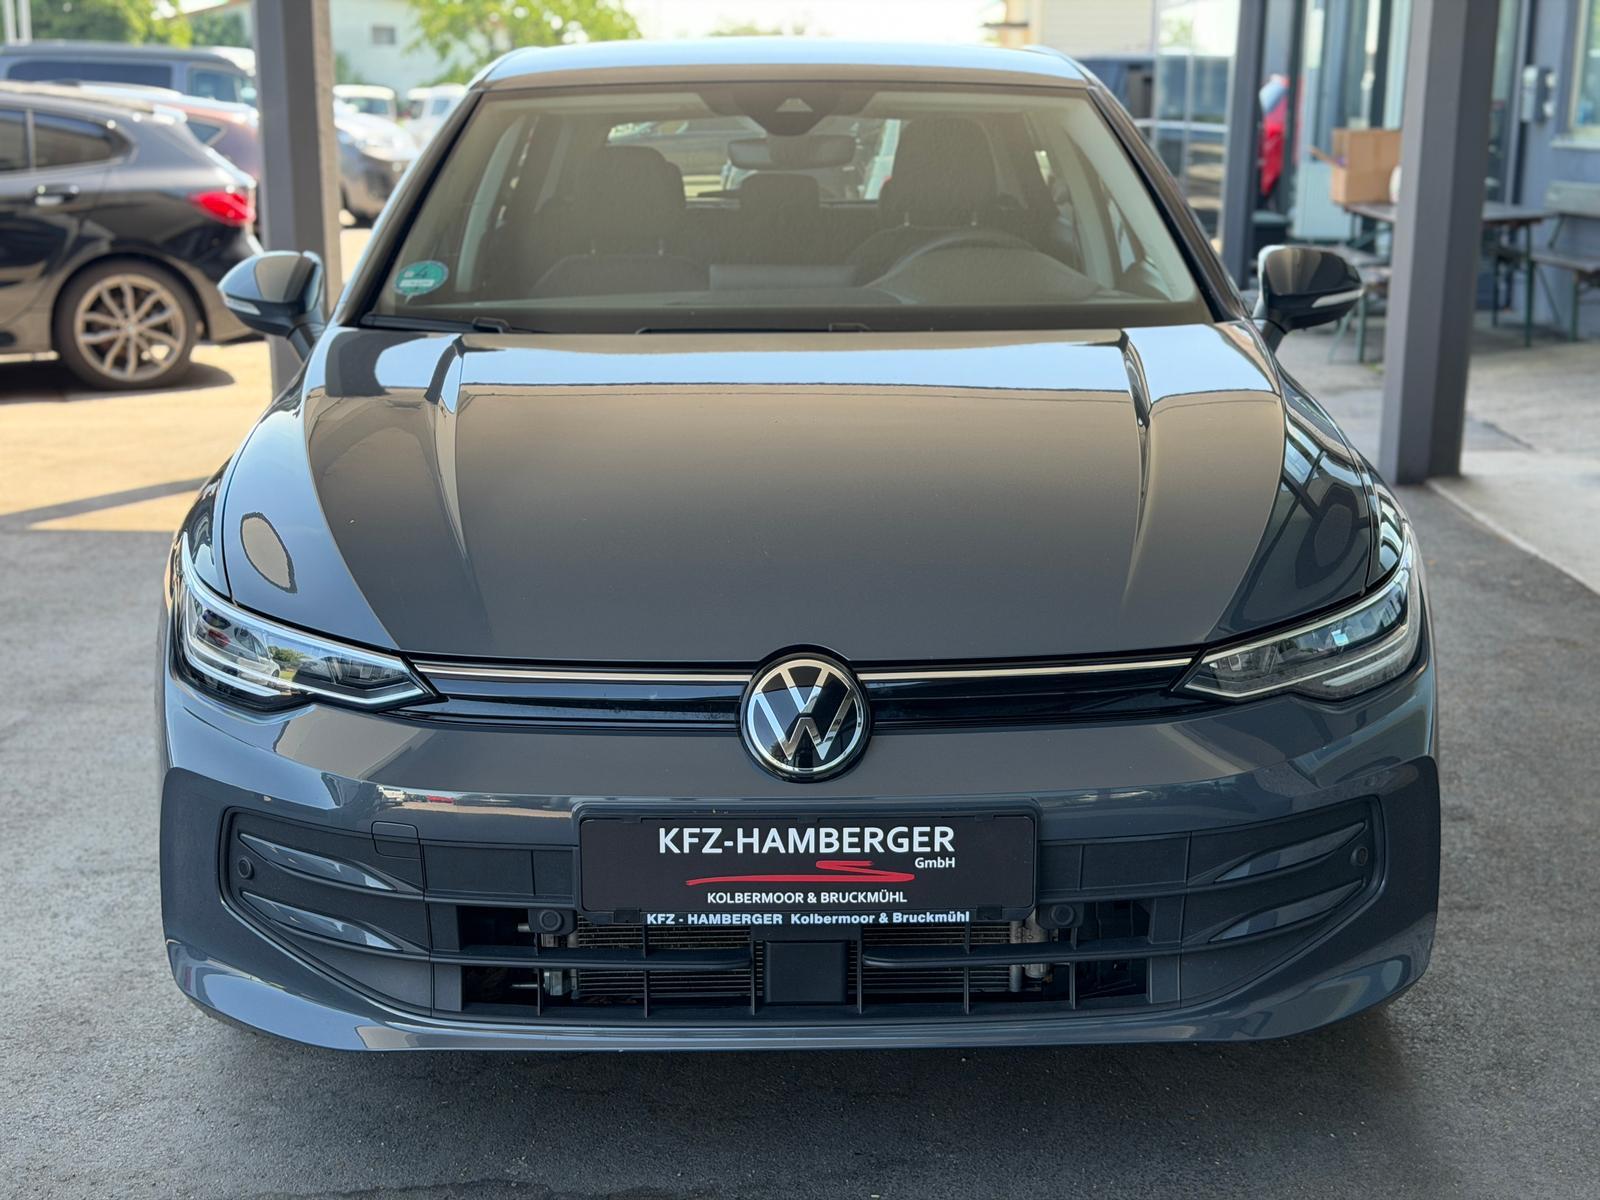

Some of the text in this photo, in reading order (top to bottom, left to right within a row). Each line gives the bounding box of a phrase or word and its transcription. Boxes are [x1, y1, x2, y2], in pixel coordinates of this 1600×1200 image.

[750, 661, 857, 764] VW
[659, 827, 955, 854] KFZ-HAMBERGER
[914, 856, 956, 869] GmbH
[707, 889, 908, 904] KOLBERMOOR & BRUCKMÜHL
[646, 913, 676, 925] KFZ
[687, 913, 783, 925] HAMBERGER
[790, 913, 876, 925] Kolbermoor
[878, 912, 889, 924] &
[892, 910, 970, 924] Bruckmühl
